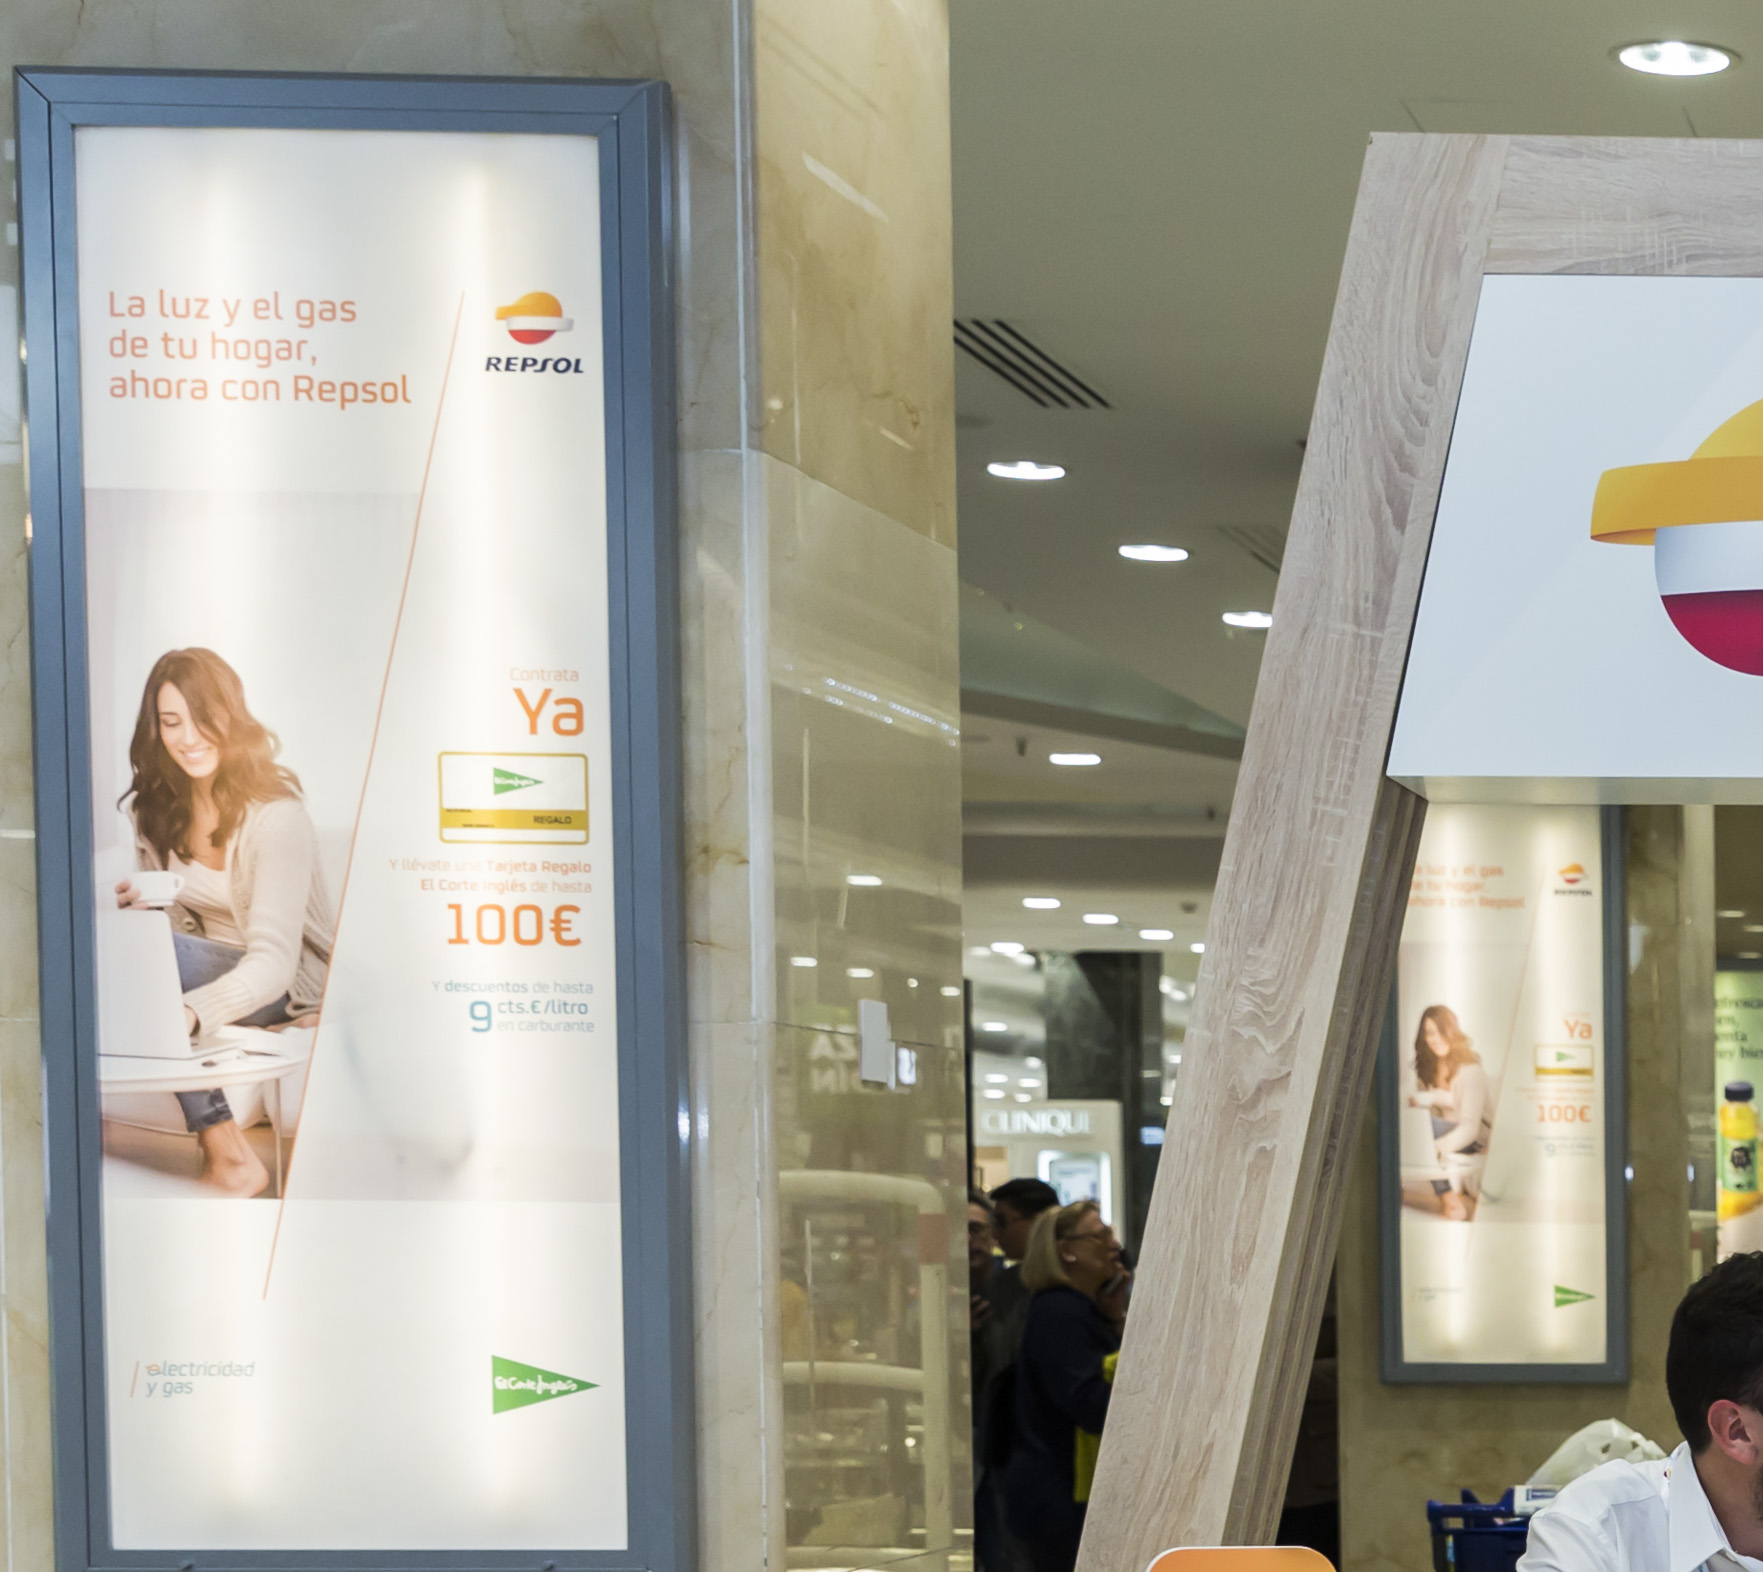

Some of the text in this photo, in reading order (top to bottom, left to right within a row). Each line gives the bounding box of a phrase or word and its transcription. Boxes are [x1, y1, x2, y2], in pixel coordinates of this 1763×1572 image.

[109, 289, 357, 329] La luz y el gas
[109, 329, 317, 368] de tu hogar,
[485, 357, 584, 374] REPSOL
[109, 369, 412, 411] ahora con Repsol
[510, 667, 579, 682] Contrata
[513, 688, 584, 736] Ya
[533, 815, 572, 825] REGALO
[389, 858, 592, 875] Y llévate una Tarjeta Regalo
[421, 878, 592, 895] El Corte Inglés de hasta
[447, 903, 582, 947] 100€
[432, 980, 594, 994] Y descuentos de hasta
[497, 1019, 595, 1032] en carburante
[146, 1381, 193, 1398] y gas
